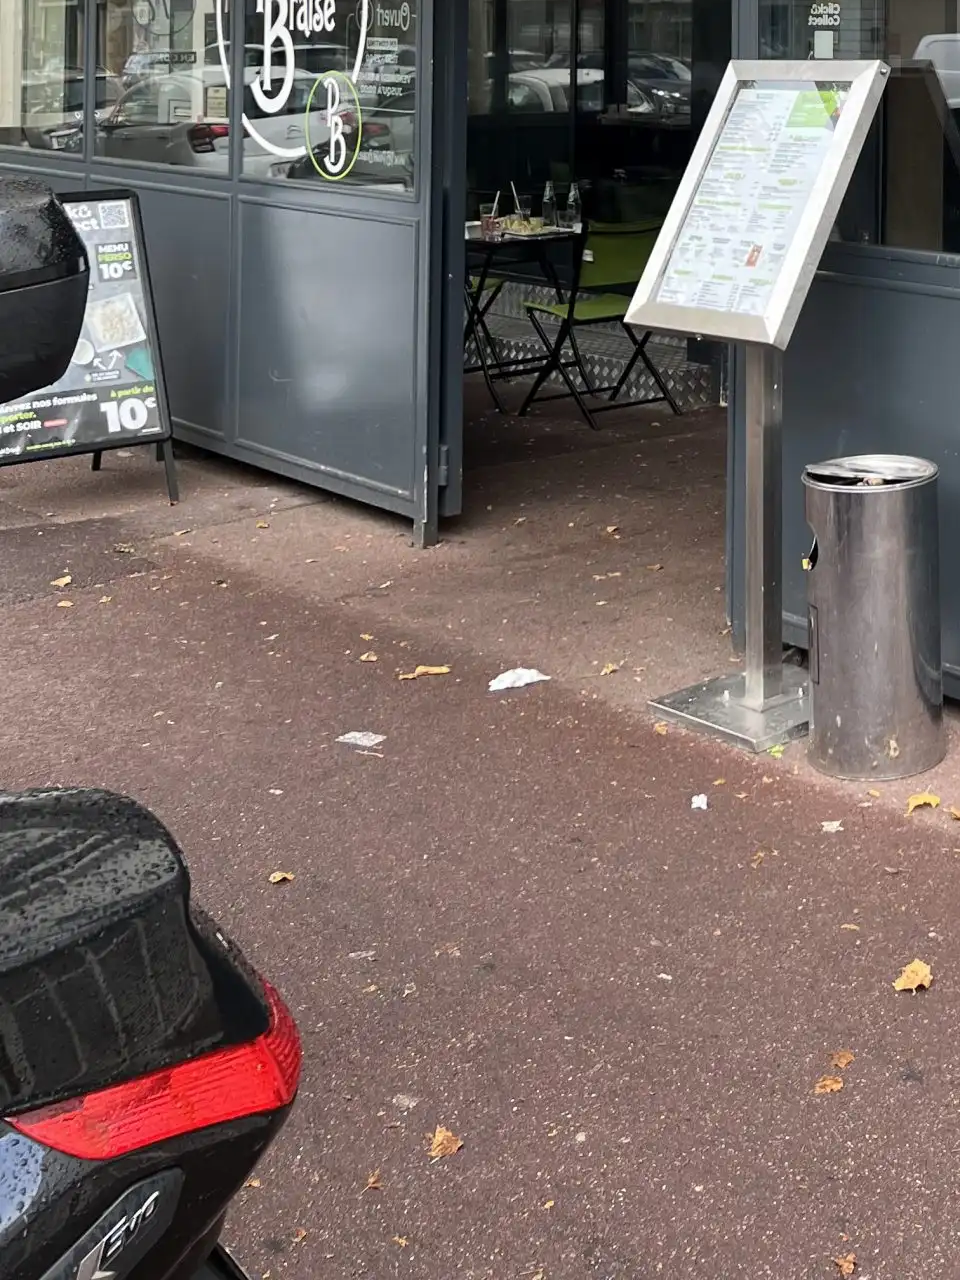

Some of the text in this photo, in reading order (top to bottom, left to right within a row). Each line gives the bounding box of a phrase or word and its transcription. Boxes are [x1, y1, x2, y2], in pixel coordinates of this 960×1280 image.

[324, 76, 346, 173] PB
[98, 243, 129, 253] MENU
[99, 260, 133, 280] 10€
[52, 392, 98, 406] formules
[100, 396, 156, 433] 10€
